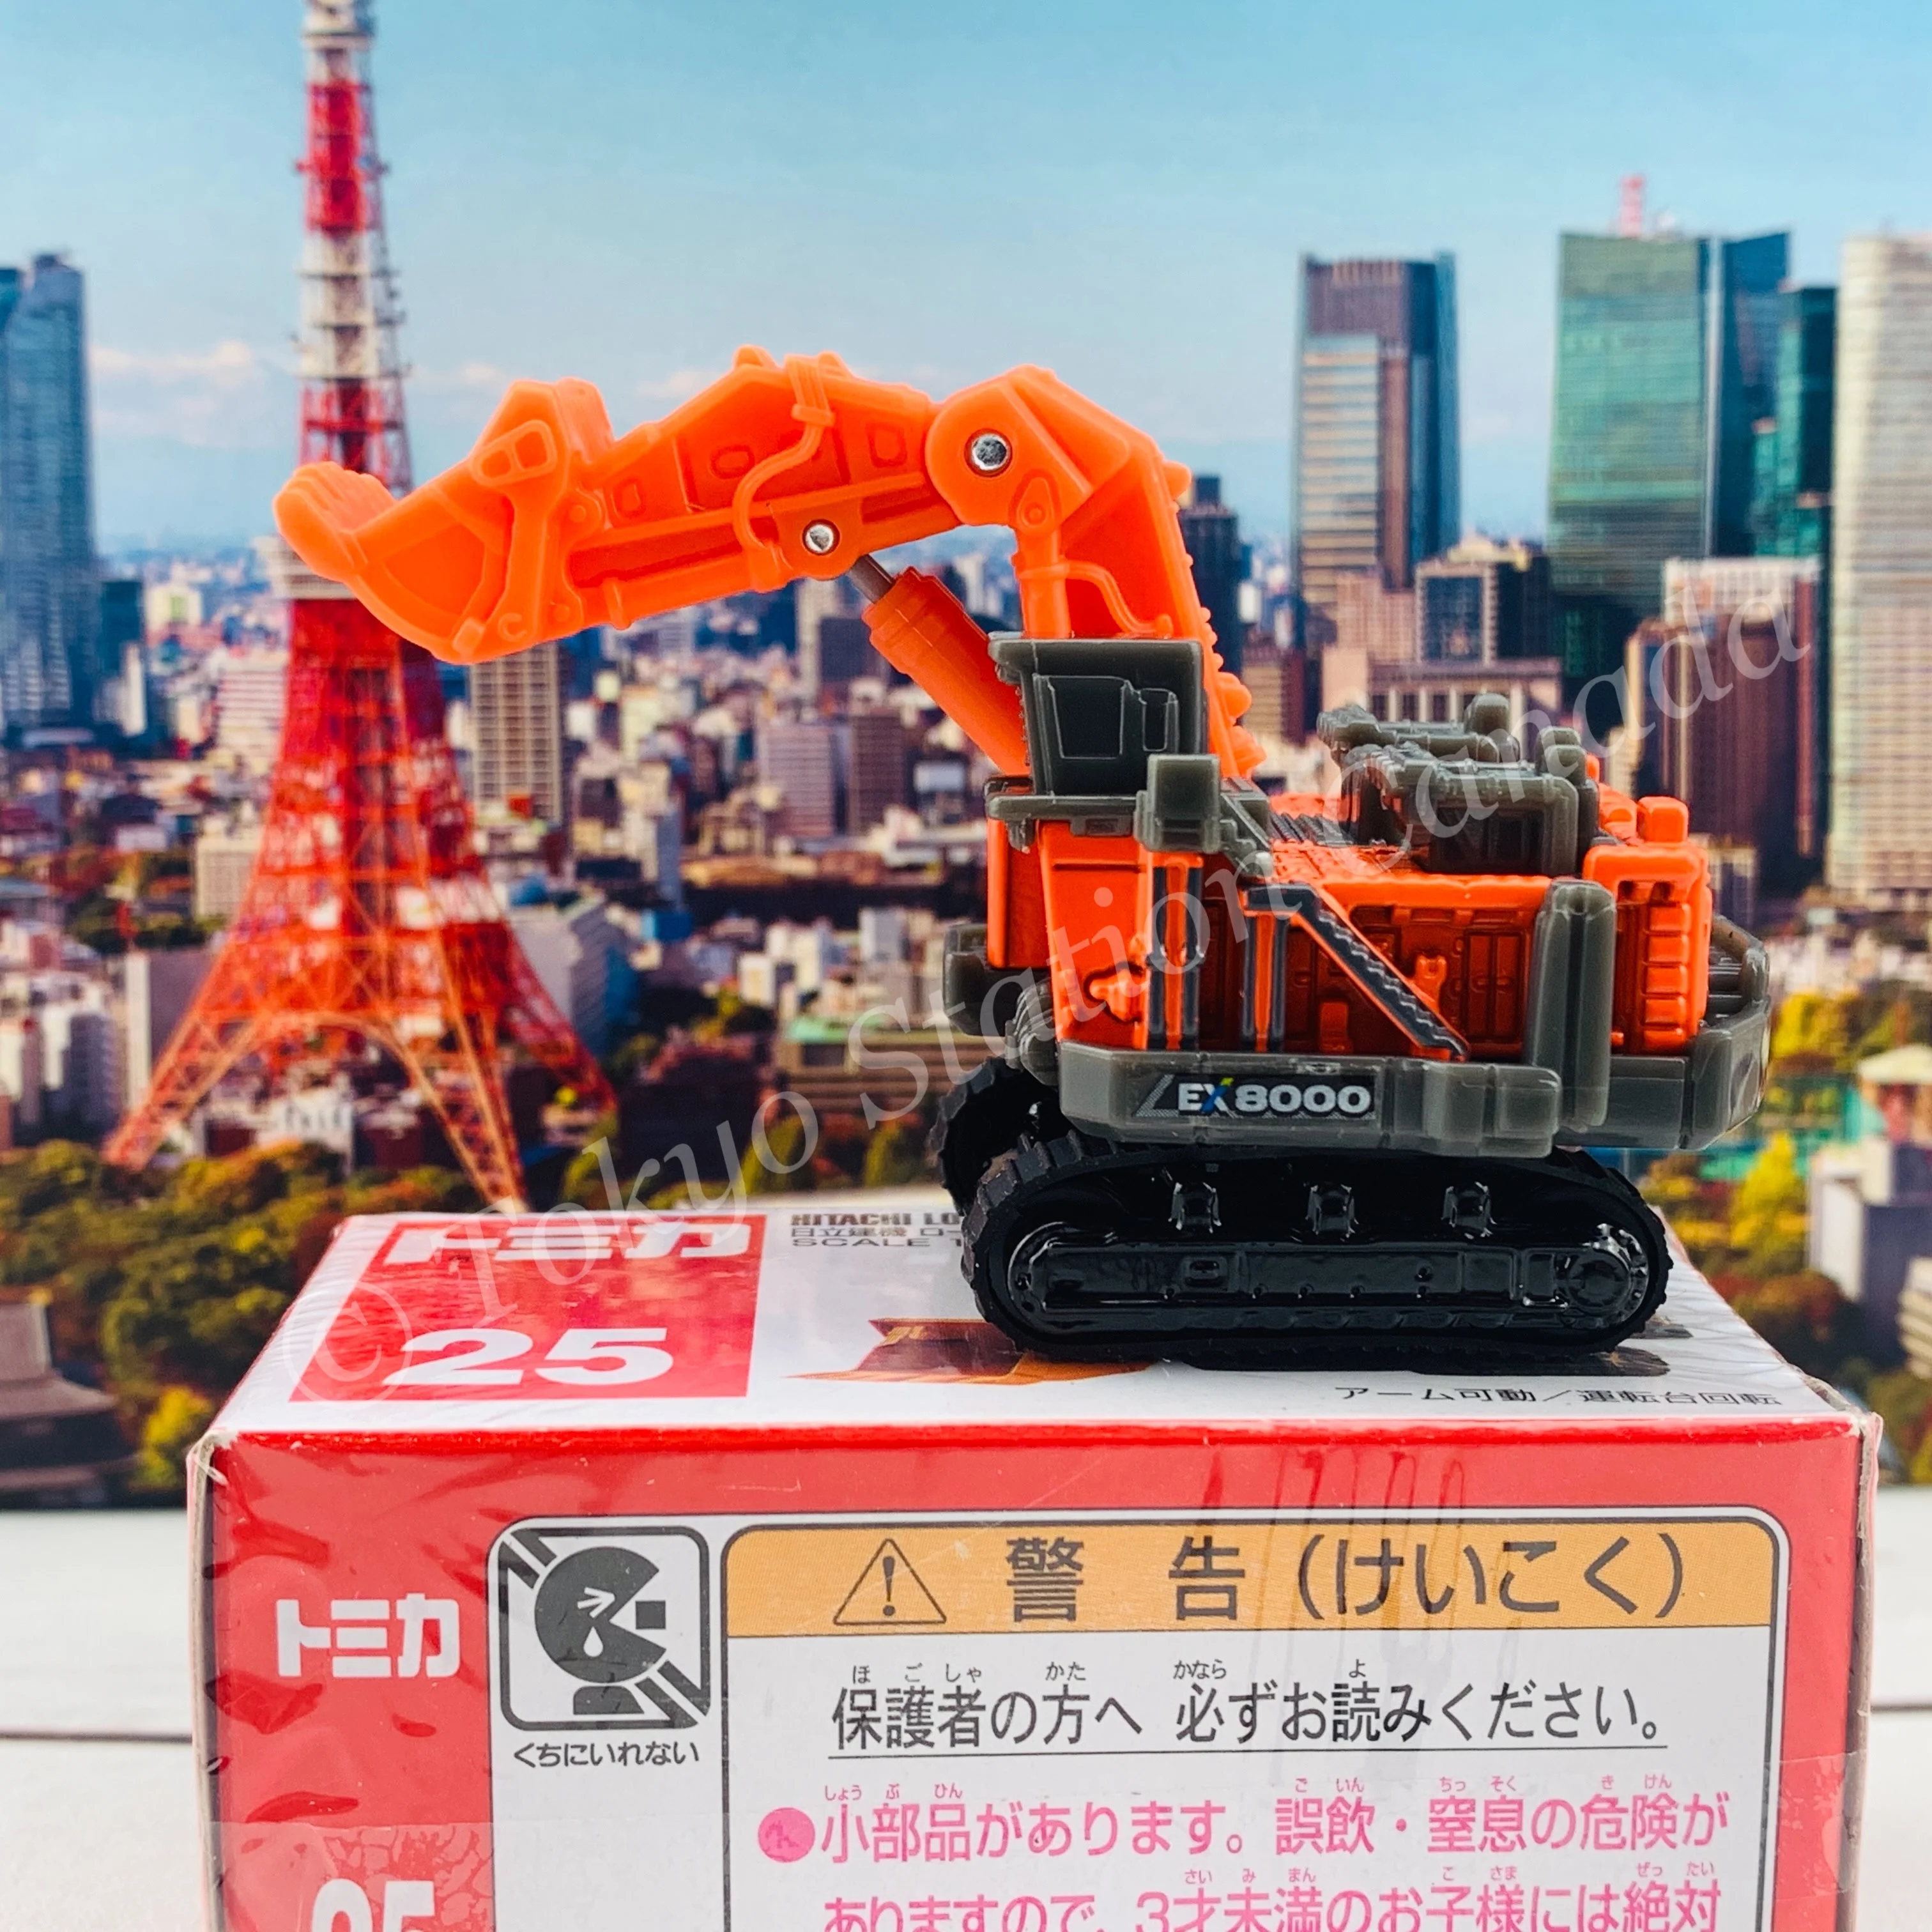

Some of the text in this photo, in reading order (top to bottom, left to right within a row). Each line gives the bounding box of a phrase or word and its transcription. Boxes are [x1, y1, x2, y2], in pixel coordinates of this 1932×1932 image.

[1178, 1077, 1372, 1116] EX8000
[790, 1212, 912, 1226] HITACHI
[385, 1220, 751, 1265] トミカ
[792, 1237, 930, 1247] SCALE
[382, 1328, 675, 1386] 25
[277, 1594, 459, 1677] トミカ
[1045, 1662, 1085, 1680] かた
[1173, 1659, 1226, 1680] かなら
[1349, 1659, 1366, 1678] よ
[832, 1685, 1142, 1750] 保護者の方へ
[514, 1741, 699, 1768] くちにいれない
[822, 1879, 1723, 1932] ありますので3才未満のお子様には絶対
